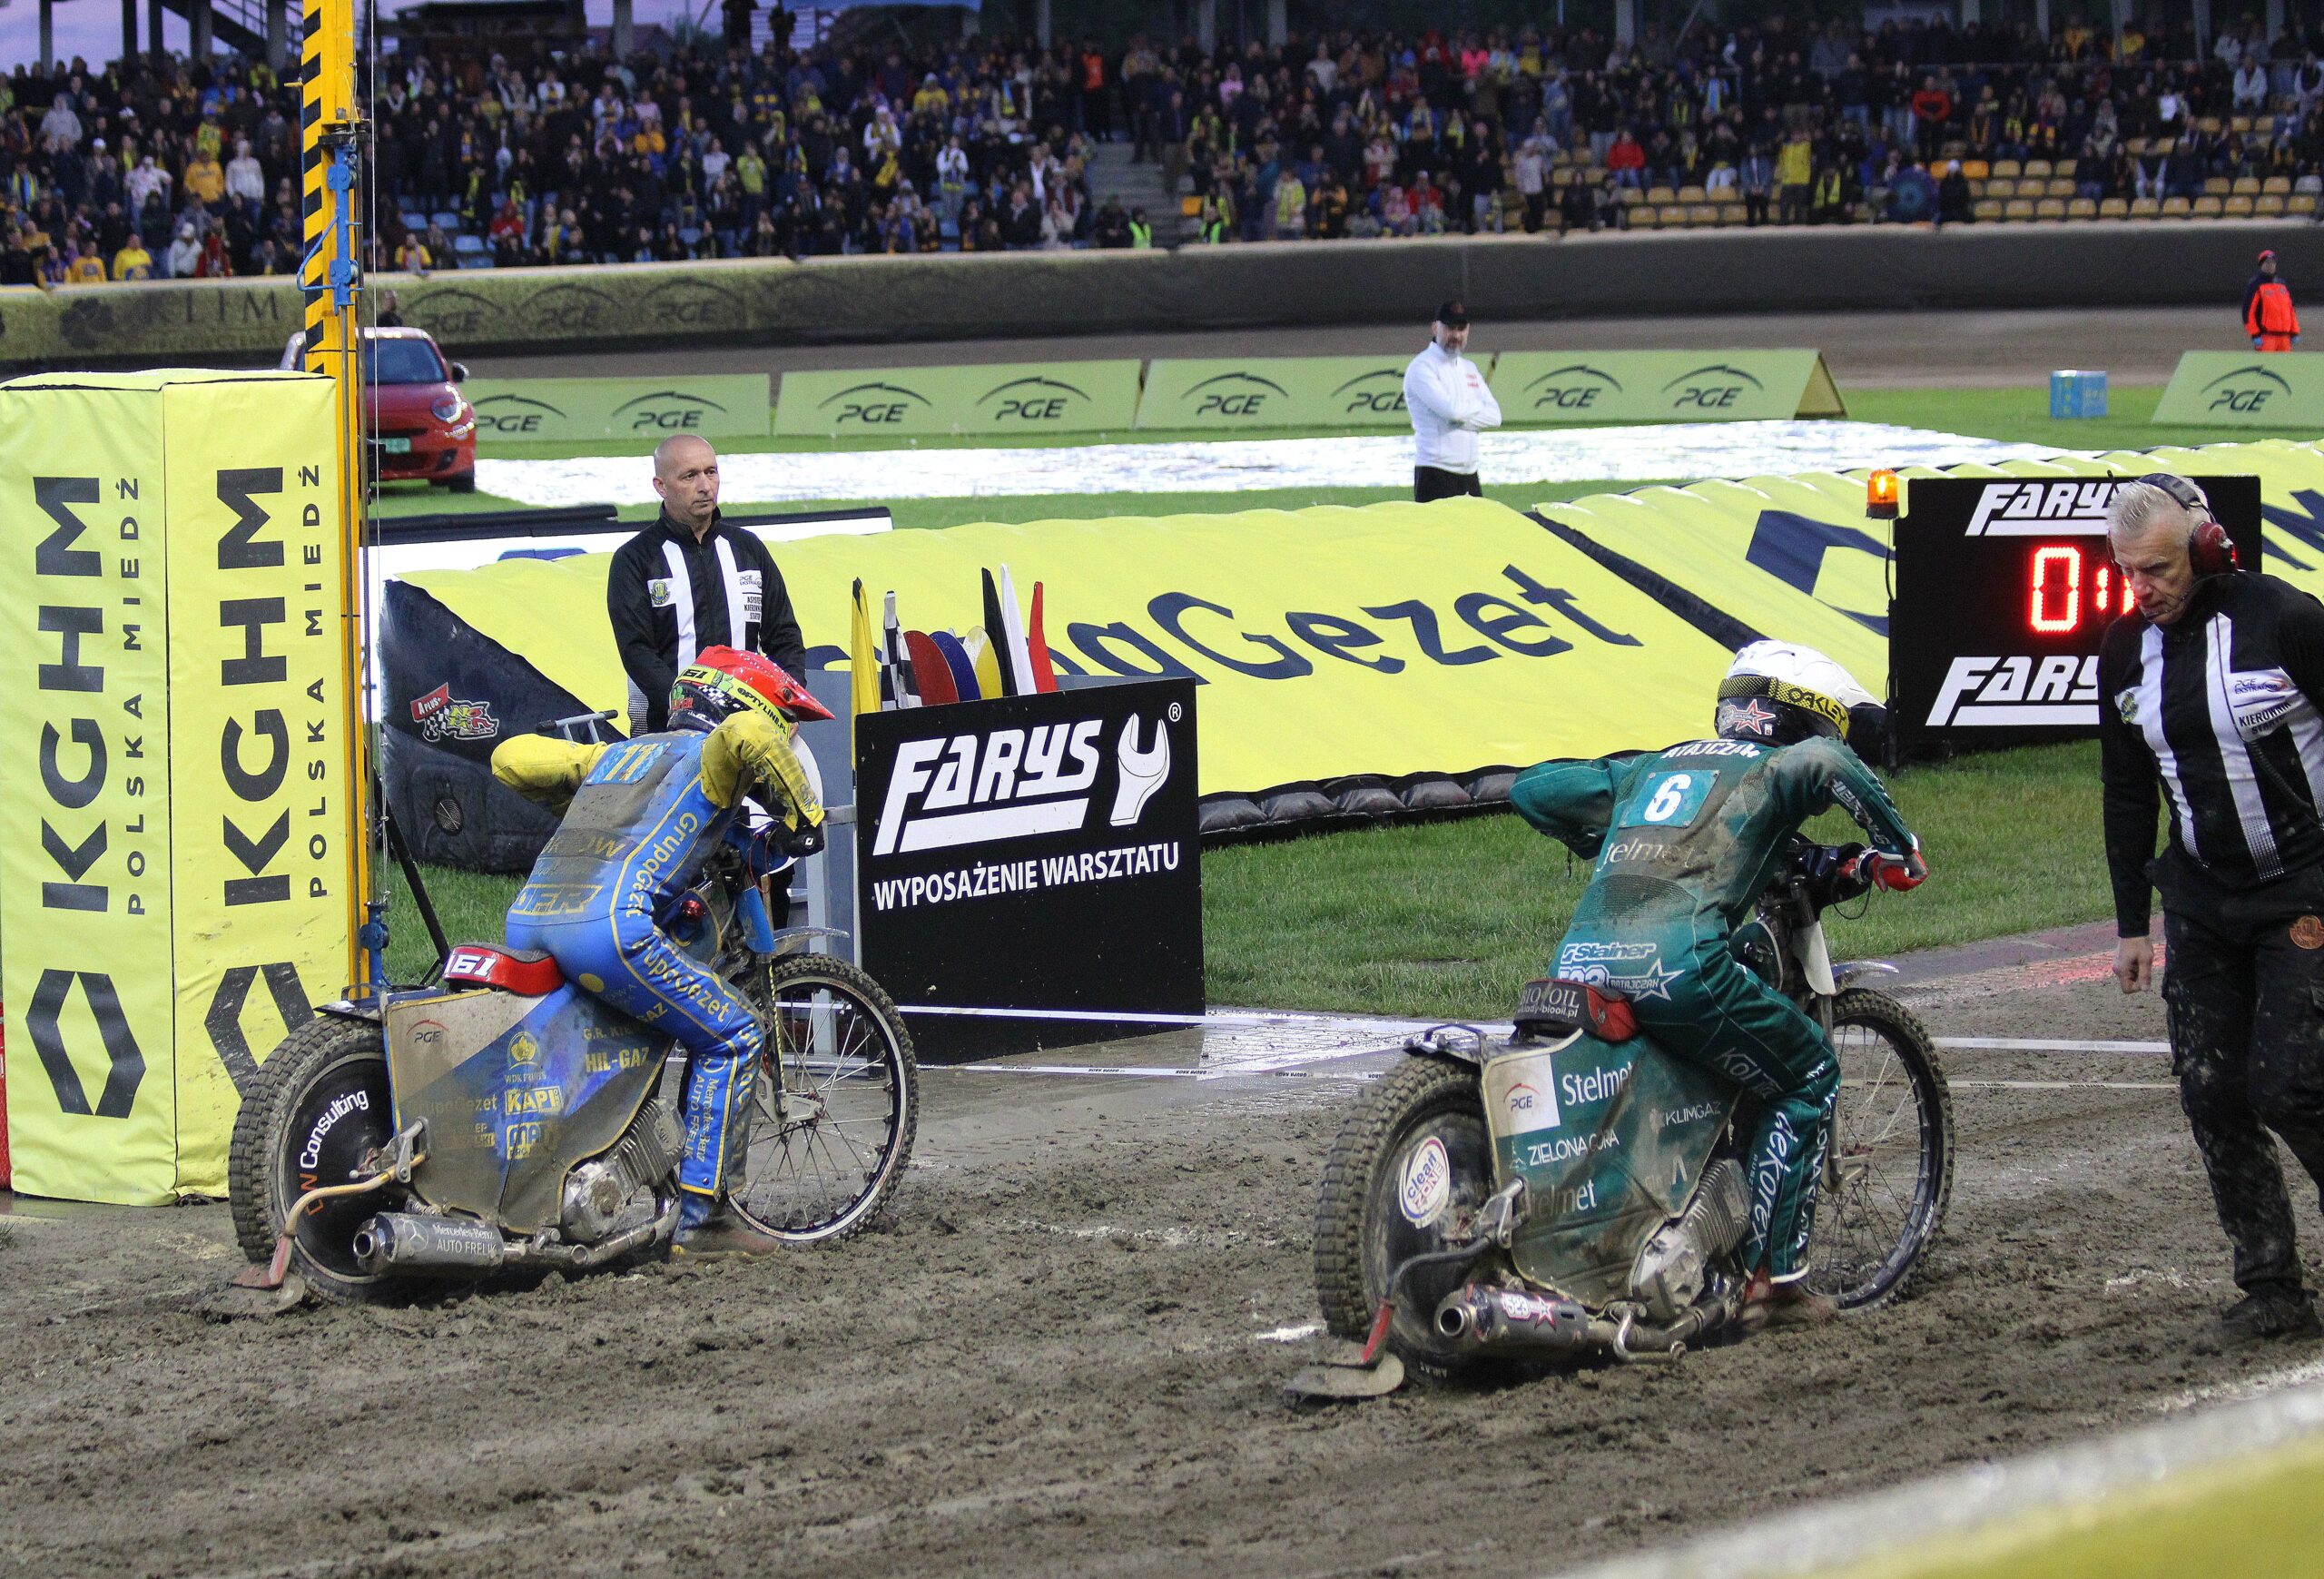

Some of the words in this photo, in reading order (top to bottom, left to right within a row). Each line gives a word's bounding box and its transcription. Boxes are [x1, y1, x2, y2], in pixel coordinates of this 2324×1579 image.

[996, 398, 1068, 420] PGE
[1196, 395, 1267, 416] PGE
[1534, 388, 1602, 409] PGE
[1673, 387, 1743, 409] PGE
[2208, 390, 2273, 413] PGE
[633, 410, 704, 429] PGE
[837, 403, 909, 423] PGE
[115, 478, 142, 650] MIEDŹ
[297, 465, 323, 637] MIEDŹ
[217, 467, 290, 906] KGHM
[683, 668, 709, 679] 61
[33, 477, 108, 913] KGHM
[1787, 686, 1847, 725] OAKLEY
[306, 676, 328, 898] POLSKA
[872, 719, 1103, 855] FARYS
[1644, 774, 1691, 822] 6
[123, 694, 145, 915] POLSKA
[873, 860, 1039, 911] WYPOSAŻENIE
[1041, 842, 1179, 887] WARSZTATU
[451, 954, 497, 977] 61
[1573, 942, 1657, 962] Stainer
[1549, 988, 1581, 1009] OIL
[414, 1031, 441, 1044] PGE
[690, 1074, 704, 1111] AUTO
[1511, 1095, 1533, 1111] PGE
[300, 1090, 369, 1169] Consulting
[696, 1078, 720, 1162] Mercedes-Benz
[1528, 1136, 1588, 1167] ZIELONA
[437, 1239, 463, 1253] AUTO
